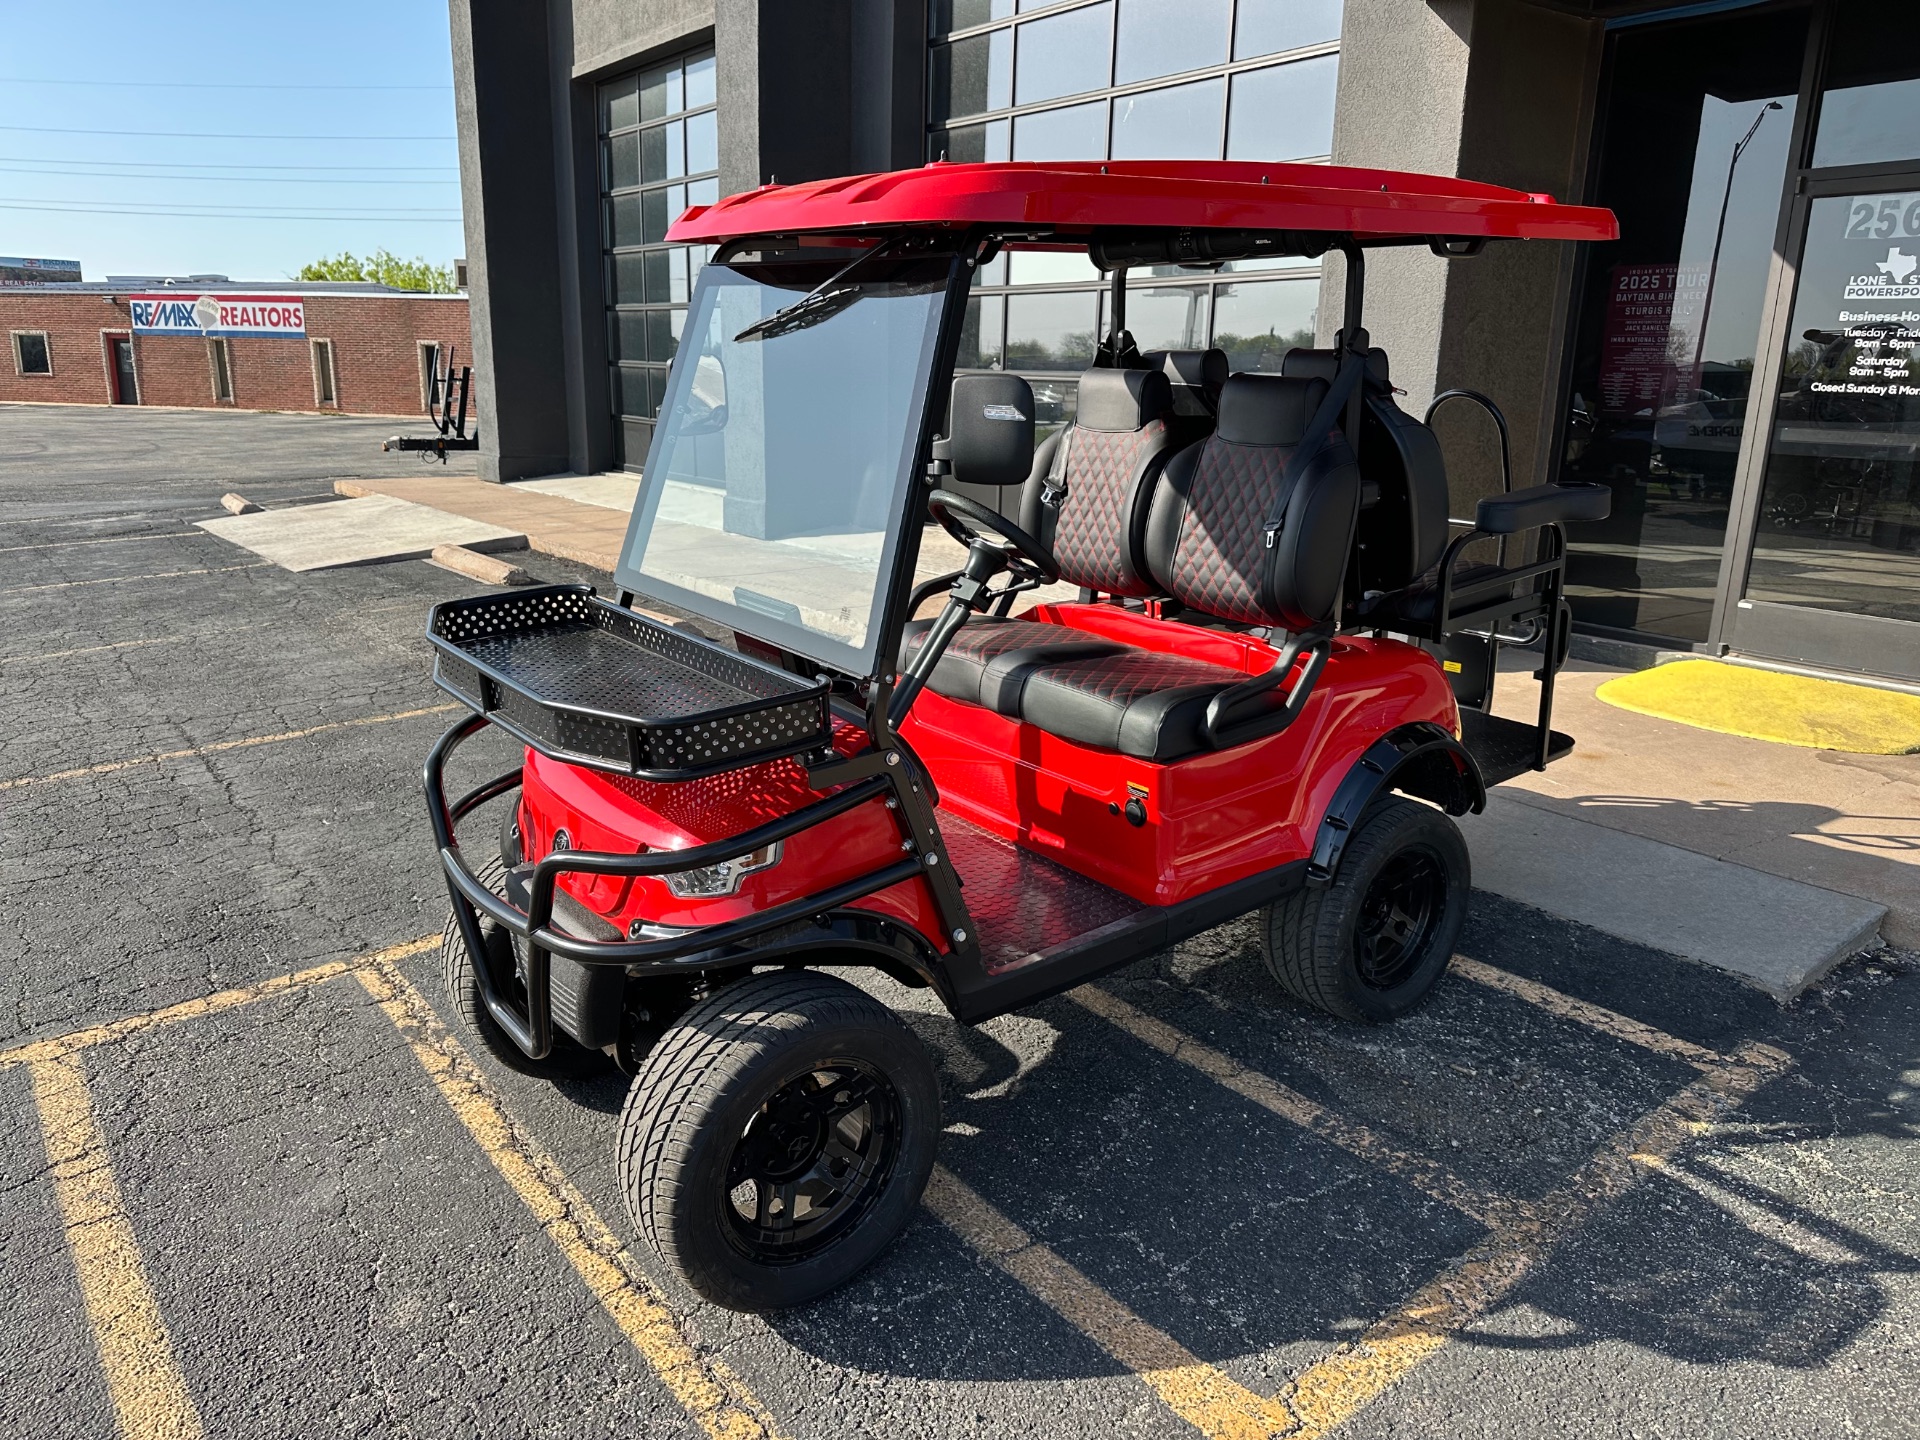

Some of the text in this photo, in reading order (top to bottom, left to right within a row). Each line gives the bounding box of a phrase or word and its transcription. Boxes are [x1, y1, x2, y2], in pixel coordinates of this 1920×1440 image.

[1619, 273, 1708, 290] 2025 TOUR
[1849, 274, 1920, 286] LONE S
[1616, 293, 1655, 302] DAYTONA
[1658, 292, 1679, 300] BIKE
[1847, 287, 1920, 297] POWERSPO
[132, 302, 303, 328] RE/MAX REALTORS
[1625, 305, 1695, 315] STURGIS RALLY
[1844, 328, 1887, 340] Tuesday
[1854, 339, 1880, 348] 9am
[1889, 339, 1916, 351] 6pm
[1856, 356, 1907, 368] Saturday
[1849, 366, 1874, 376] 9am
[1883, 367, 1910, 379] 5pm
[1810, 382, 1845, 392] Closed
[1846, 383, 1887, 397] Sunday
[1888, 385, 1897, 395] &
